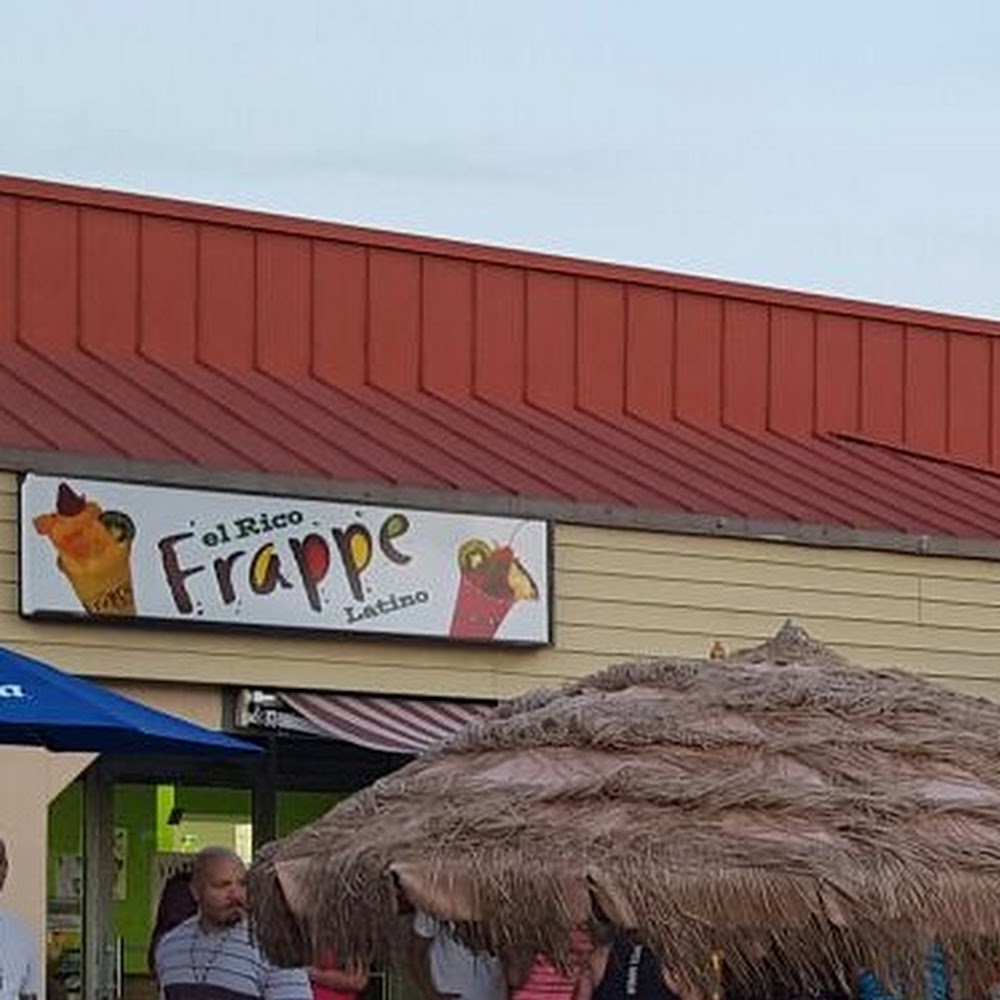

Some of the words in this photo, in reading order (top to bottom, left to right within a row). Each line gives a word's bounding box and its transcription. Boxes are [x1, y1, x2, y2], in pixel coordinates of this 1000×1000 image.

[202, 523, 232, 548] el
[234, 510, 304, 539] Rico
[157, 513, 412, 614] Frappe
[343, 590, 430, 623] Latino
